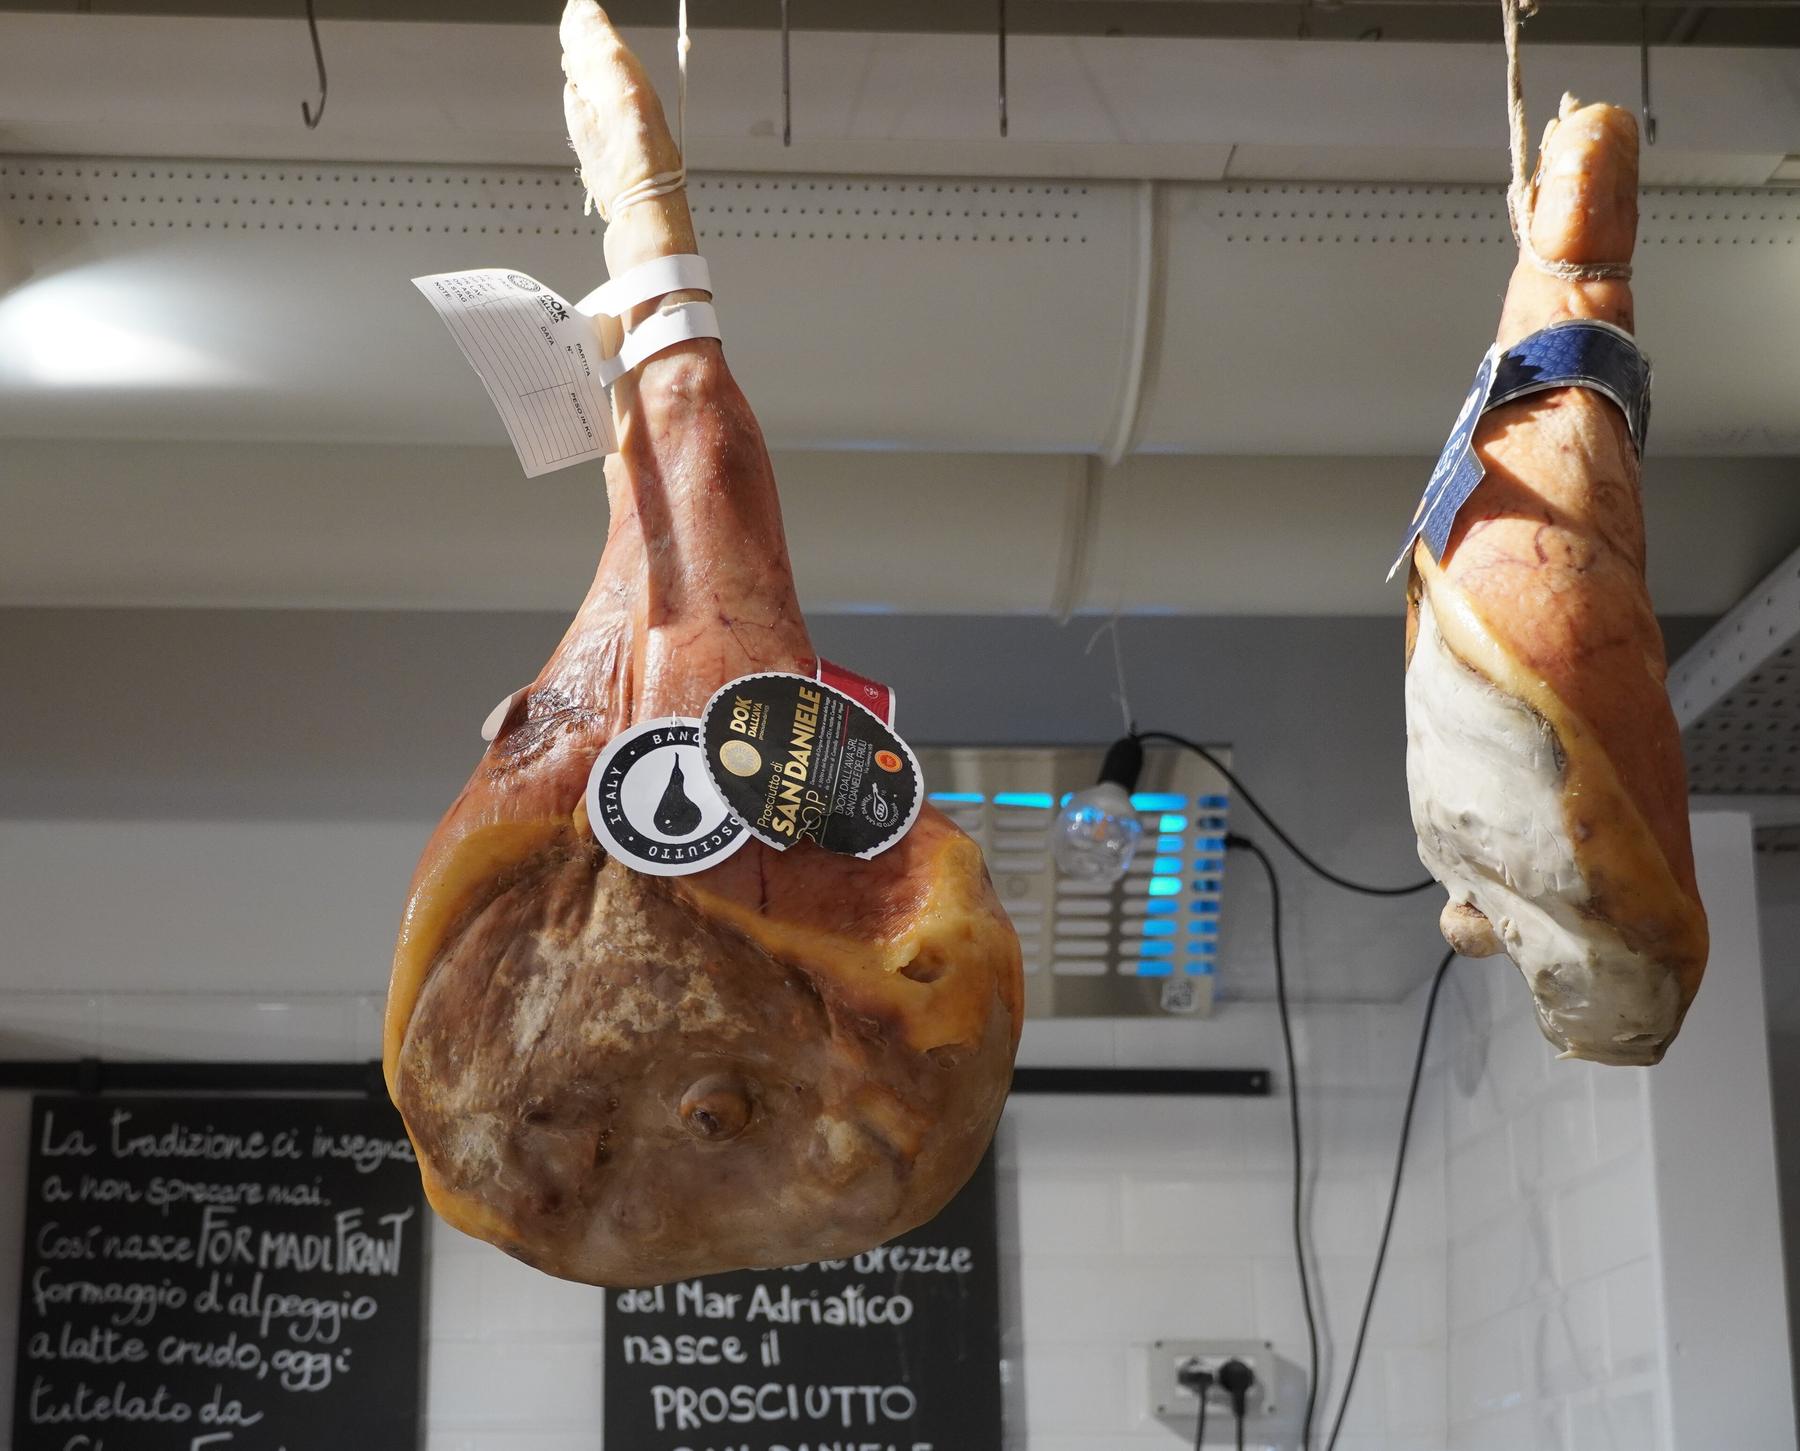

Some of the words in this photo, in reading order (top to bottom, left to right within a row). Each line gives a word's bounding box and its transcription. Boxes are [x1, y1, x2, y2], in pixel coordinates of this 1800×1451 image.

[543, 294, 569, 321] DOK
[541, 326, 554, 346] DATA
[575, 343, 590, 377] PARTITA
[571, 392, 582, 415] PESO
[580, 415, 587, 424] IN
[730, 696, 752, 734] DOK
[748, 703, 763, 737] DALL'AVA
[784, 686, 821, 781] DANIELE
[839, 751, 855, 791] DALL'AVA
[847, 736, 857, 751] SRL
[853, 758, 863, 771] DEL
[606, 766, 623, 825] ITALY
[757, 773, 781, 828] Prosciutto
[770, 761, 783, 772] di
[848, 771, 861, 800] DANIELE
[772, 780, 804, 837] SAN
[844, 800, 855, 817] SAN
[876, 803, 886, 818] SD
[41, 1109, 97, 1157] La
[312, 1125, 416, 1173] insegna
[42, 1175, 73, 1202] a
[80, 1174, 142, 1203] non
[103, 1234, 195, 1261] nasce
[33, 1265, 187, 1327] formaggio
[194, 1271, 378, 1344] d'alpeggio
[616, 1285, 666, 1314] del
[676, 1280, 741, 1319] Mar
[746, 1284, 914, 1328] Adriatico
[59, 1321, 149, 1365] latte
[157, 1331, 269, 1380] crudo,
[271, 1348, 352, 1392] oggi
[624, 1334, 748, 1366] nasce
[760, 1330, 780, 1367] il
[29, 1375, 192, 1423] tutelato
[199, 1384, 264, 1426] da
[650, 1383, 917, 1431] PROSCIUTTO
